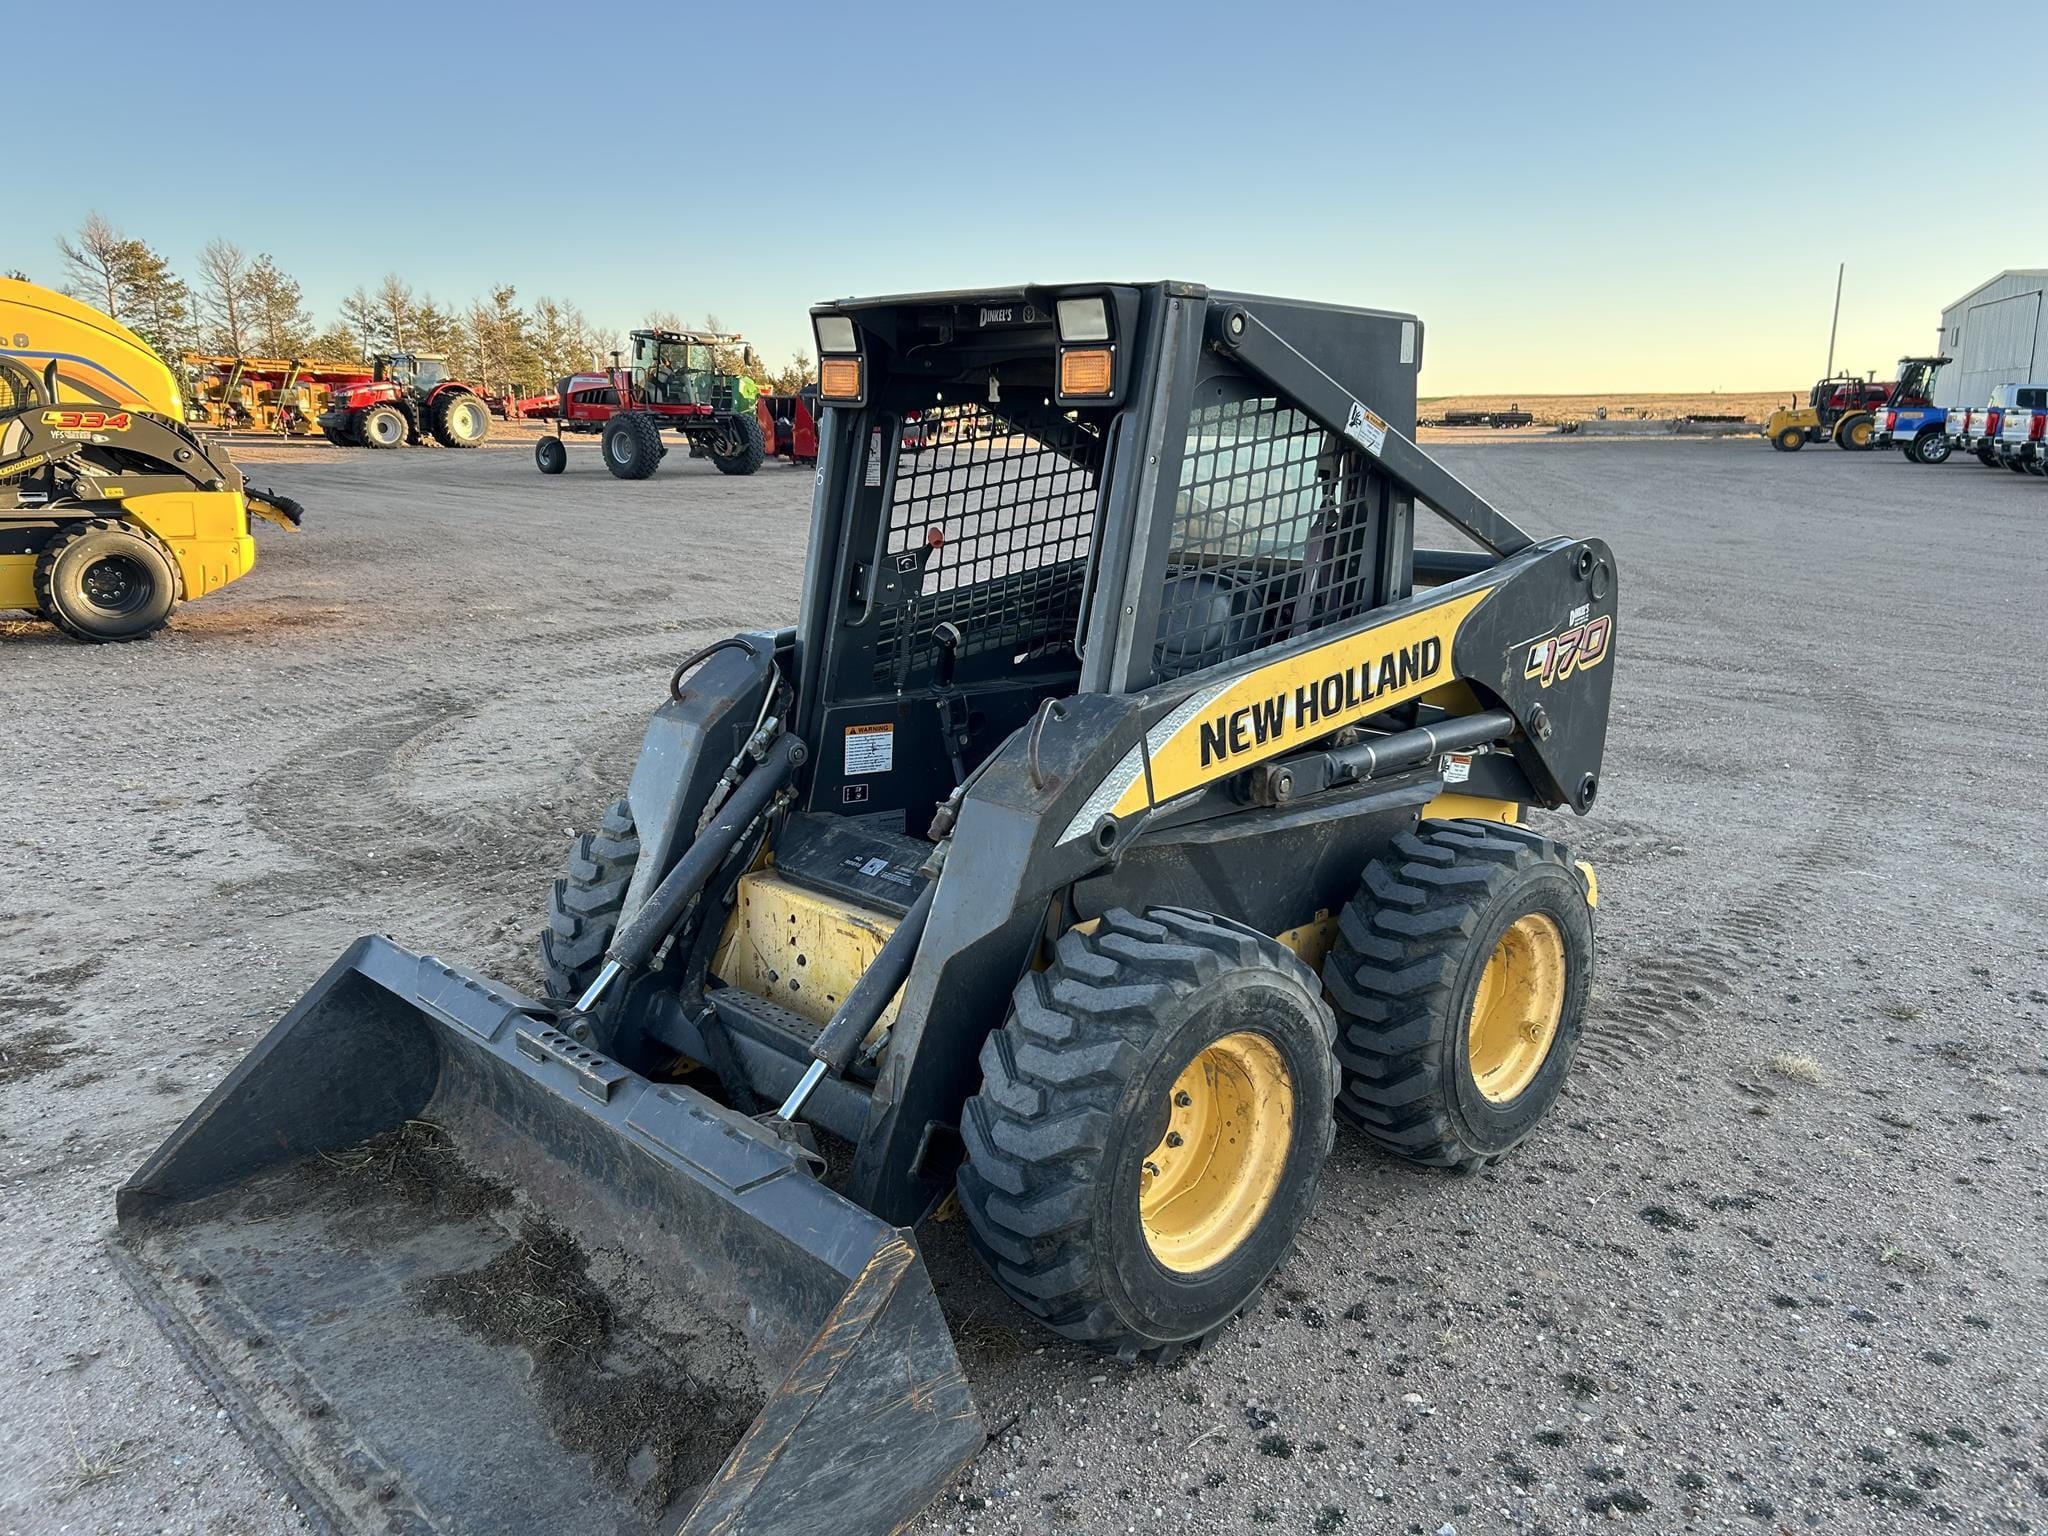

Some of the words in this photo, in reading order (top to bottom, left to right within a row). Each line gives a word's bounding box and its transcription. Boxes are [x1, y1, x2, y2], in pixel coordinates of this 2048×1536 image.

[979, 307, 1013, 327] DINKEL'S
[41, 411, 132, 431] L334
[1524, 614, 1612, 689] L170
[1200, 694, 1287, 768] NEW
[1295, 634, 1443, 730] HOLLAND
[857, 724, 889, 734] WARNING
